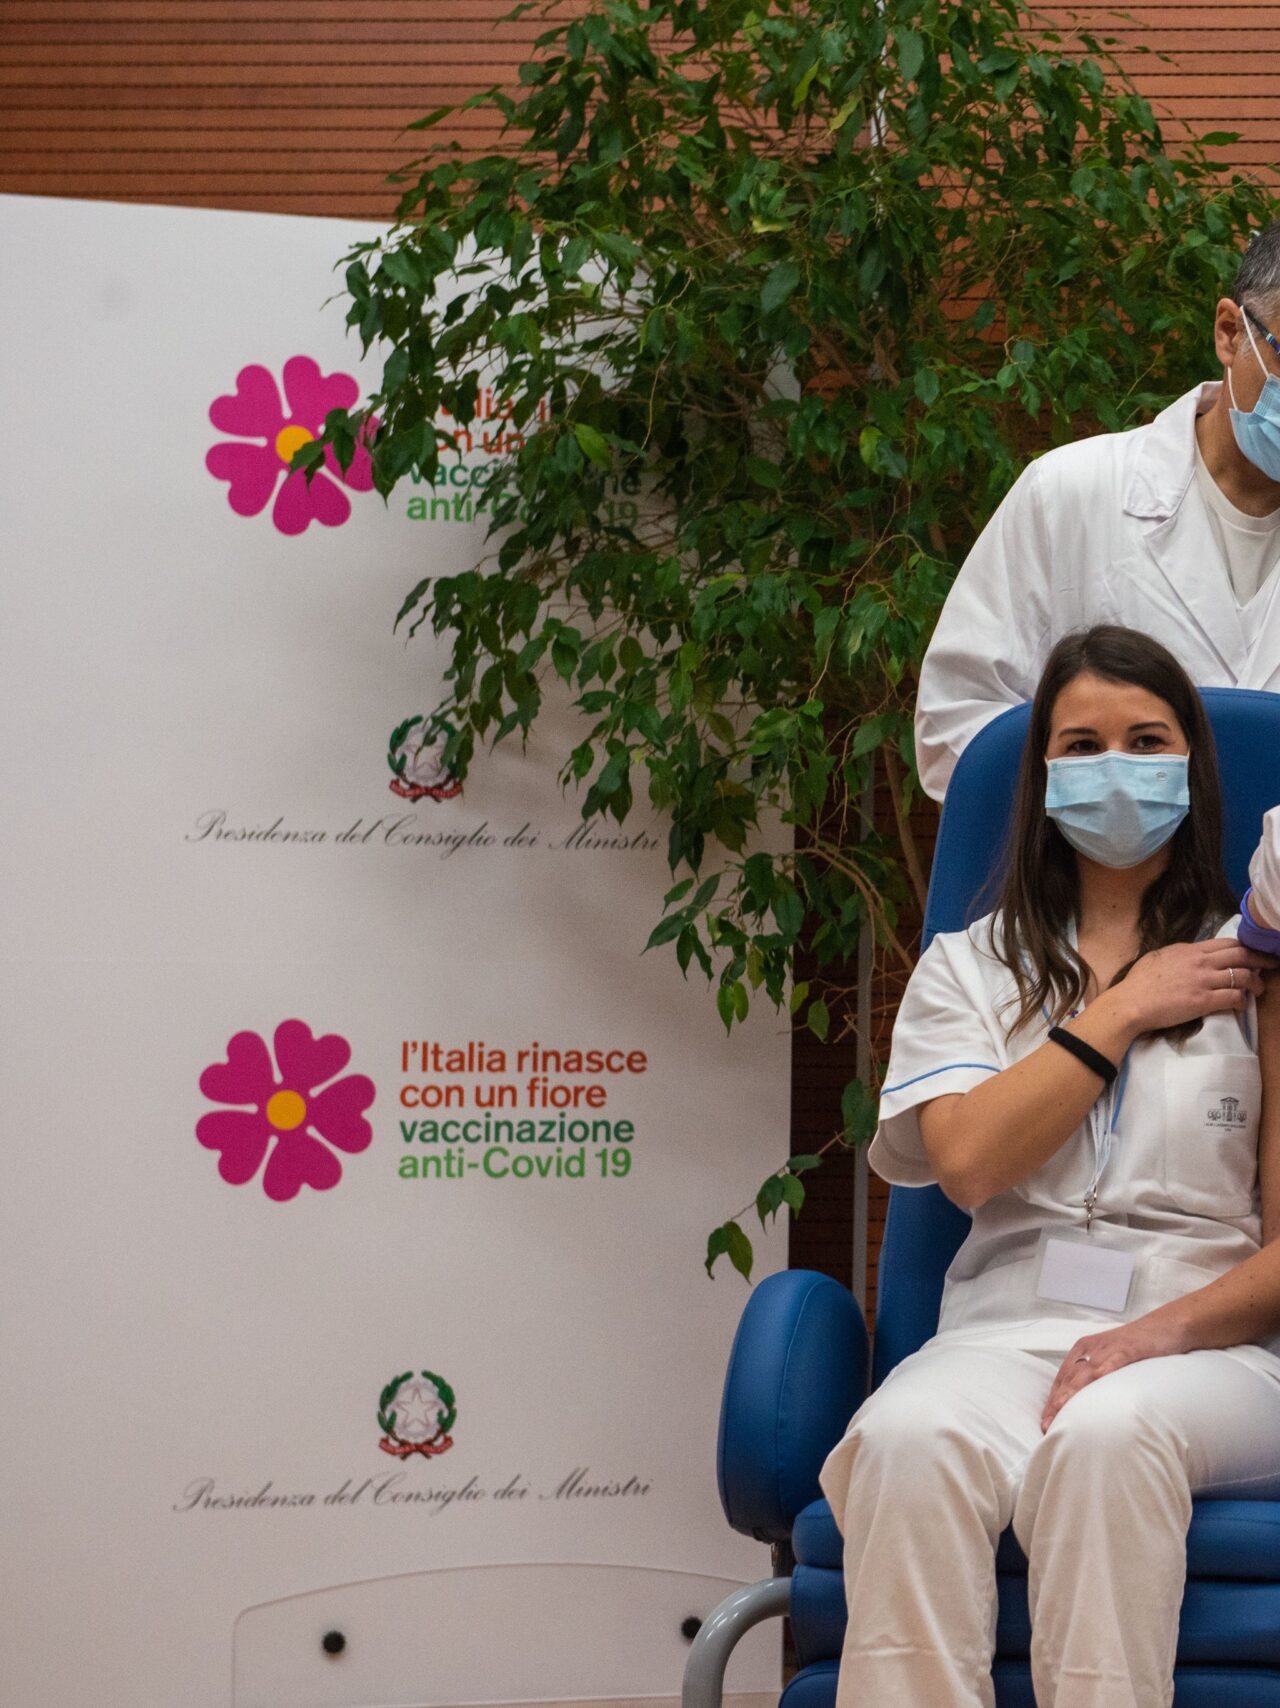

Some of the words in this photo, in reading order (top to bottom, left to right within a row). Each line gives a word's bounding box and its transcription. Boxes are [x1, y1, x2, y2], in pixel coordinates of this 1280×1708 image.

[185, 809, 327, 843] Presidenza
[335, 818, 383, 844] del
[382, 813, 497, 861] Consiglio
[503, 822, 540, 848] dei
[548, 819, 663, 850] Ministri
[402, 1040, 506, 1073] l'Italia
[517, 1042, 648, 1074] rinasce
[400, 1084, 465, 1108] con
[475, 1084, 518, 1108] un
[527, 1076, 607, 1109] fiore
[400, 1111, 635, 1144] vaccinazione
[399, 1146, 585, 1179] anti-Covid
[595, 1147, 632, 1178] 19
[173, 1476, 316, 1512] Presidenza
[324, 1478, 373, 1505] del
[372, 1471, 487, 1517] Consiglio
[493, 1473, 532, 1500] dei
[538, 1467, 655, 1500] Ministri
